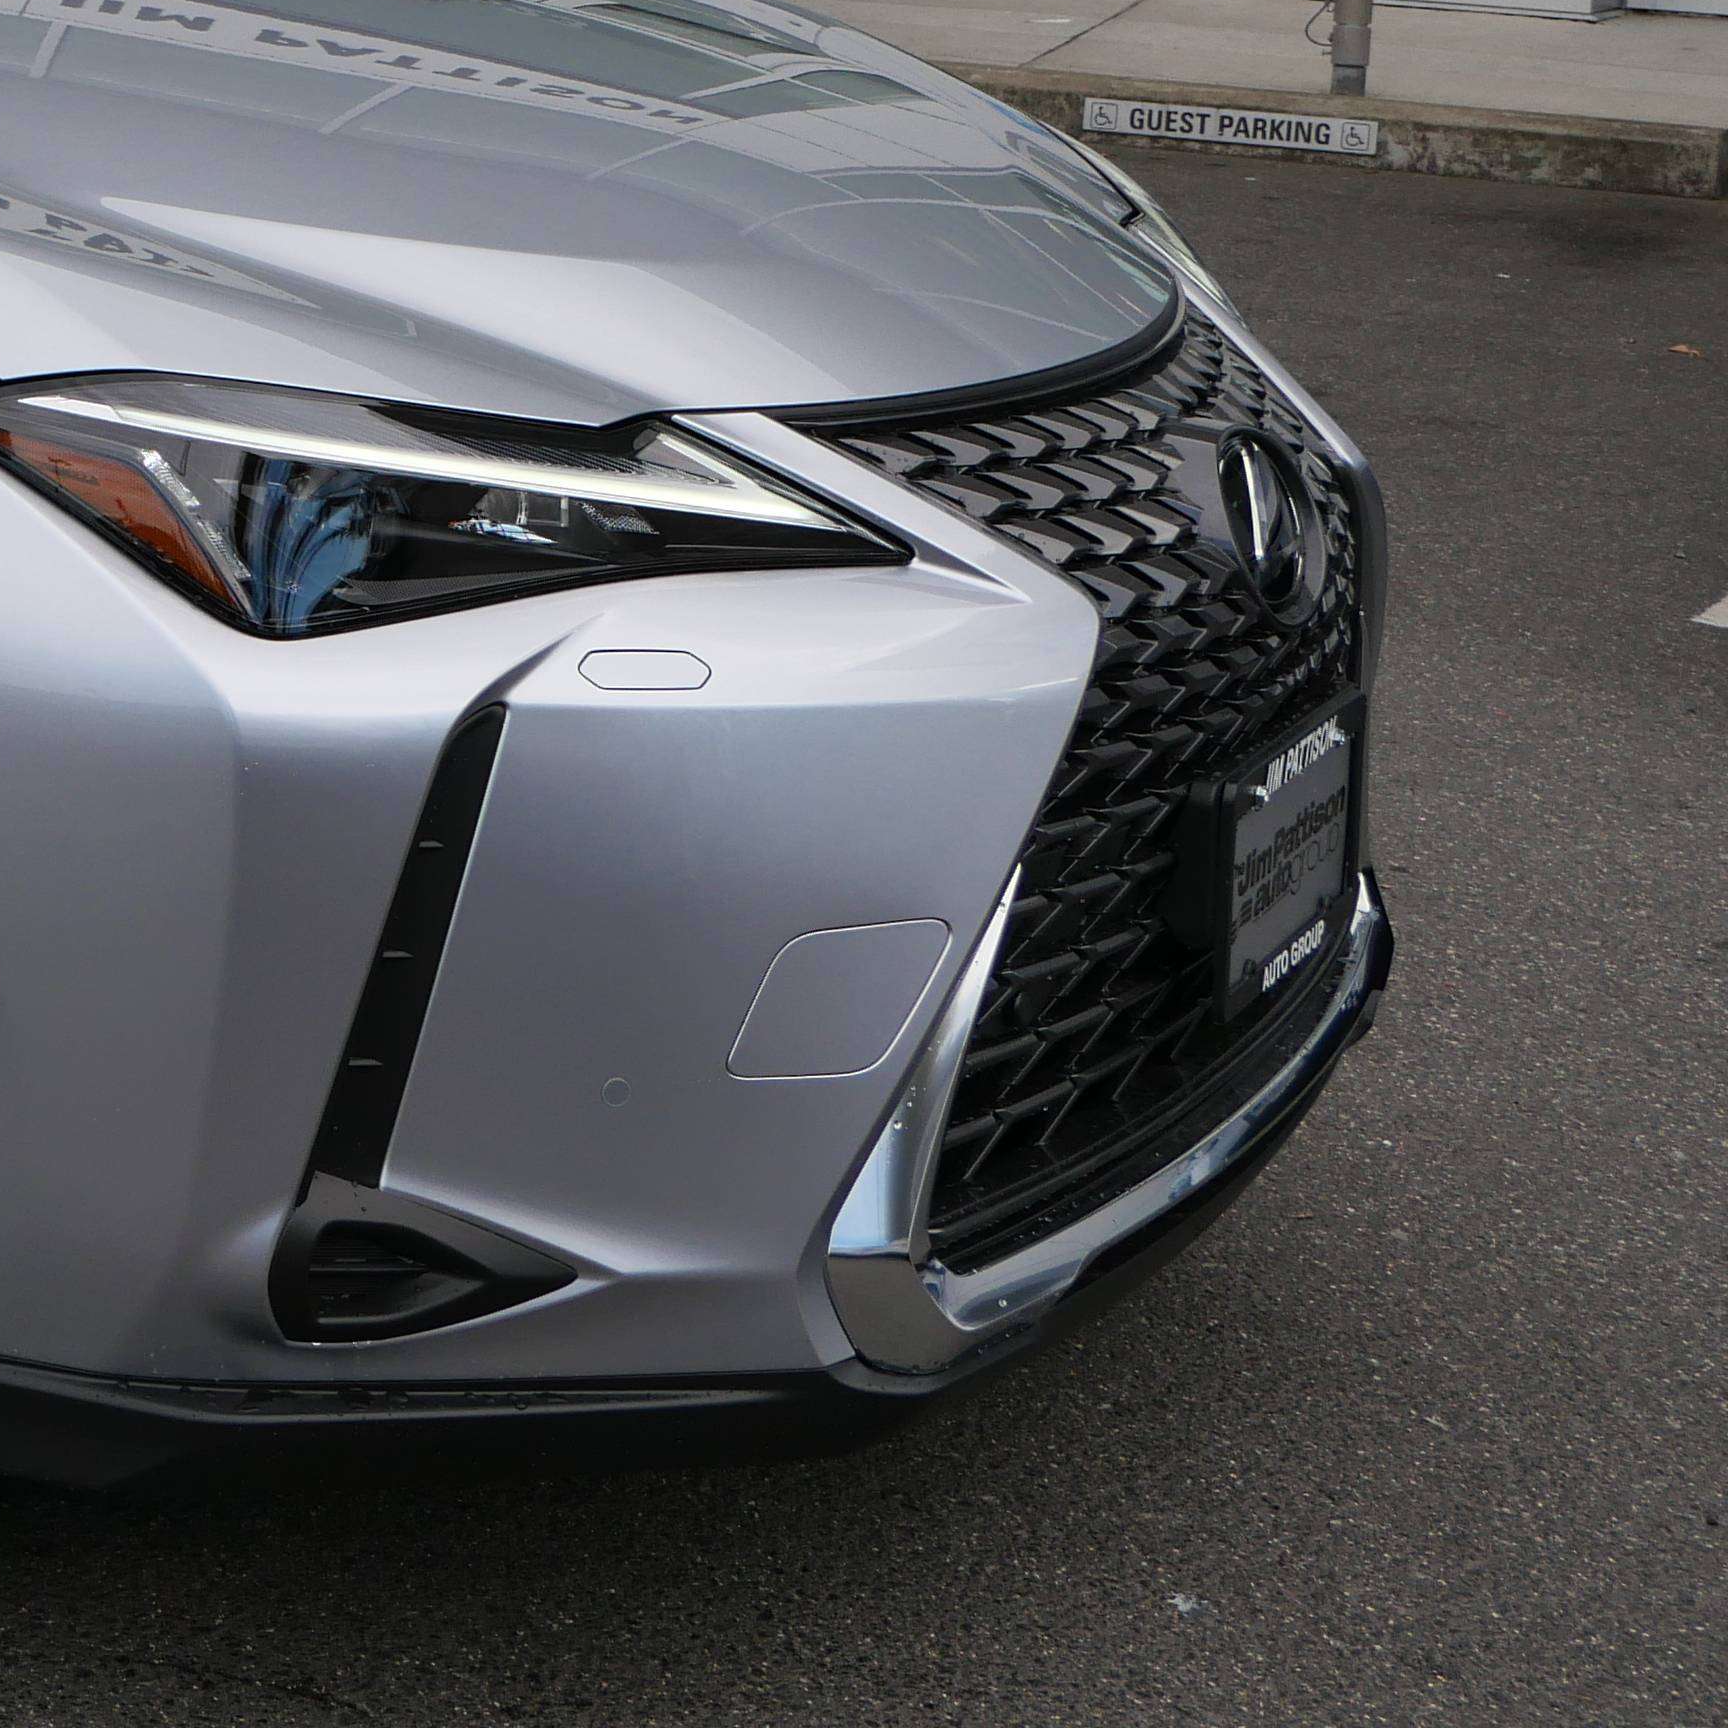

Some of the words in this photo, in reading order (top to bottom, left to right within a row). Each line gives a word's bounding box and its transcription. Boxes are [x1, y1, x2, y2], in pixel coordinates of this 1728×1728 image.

[1129, 108, 1211, 136] GUEST
[1218, 114, 1331, 146] PARKING
[1265, 754, 1286, 795] JIM
[1262, 949, 1289, 992] AUTO
[1290, 919, 1326, 967] GROUP
